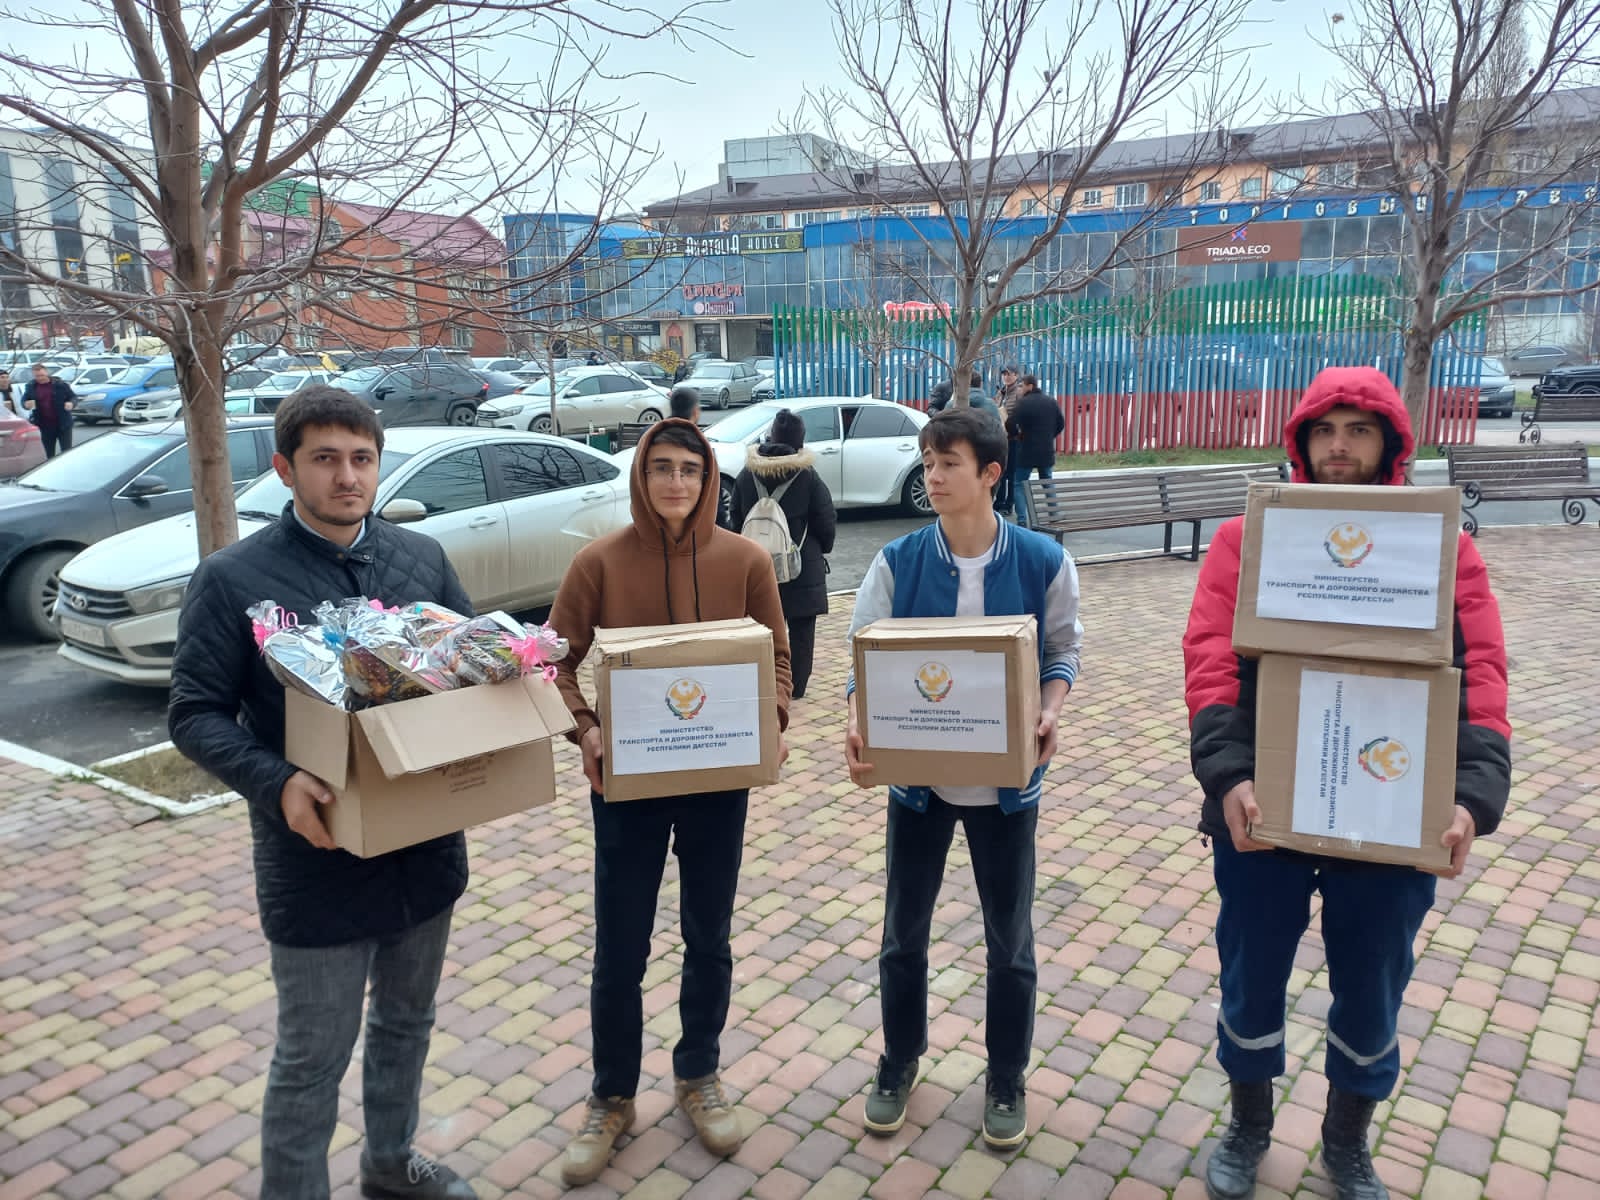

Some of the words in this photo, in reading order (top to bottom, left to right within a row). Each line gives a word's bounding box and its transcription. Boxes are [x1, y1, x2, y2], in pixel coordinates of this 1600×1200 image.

[748, 236, 780, 250] HOUSE
[1207, 246, 1246, 257] TRIADA
[1248, 244, 1271, 255] ECO
[1314, 574, 1379, 584] МИНИСТЕРСТВО
[1266, 581, 1317, 590] ТРАНСПОРТА
[1326, 584, 1378, 593] ДОРОЖНОГО
[1380, 586, 1430, 596] ХОЗЯЙСТВА
[1297, 592, 1350, 601] РЕСПУБЛИКИ
[1351, 593, 1394, 603] ДАГЕСТАН
[1335, 680, 1343, 729] ТРАНСПОРТА
[920, 716, 961, 724] ДОРОЖНОГО
[659, 725, 714, 734] МИНИСТЕРСТВО
[897, 724, 939, 732] РЕСПУБЛИКИ
[940, 725, 974, 733] ДАГЕСТАН
[1322, 709, 1330, 757] РЕСПУБЛИКИ
[619, 737, 664, 746] ТРАНСПОРТА
[671, 734, 714, 743] ДОРОЖНОГО
[646, 744, 691, 753] РЕСПУБЛИКИ
[692, 742, 727, 750] ДАГЕСТАН
[1330, 735, 1339, 784] ДОРОЖНОГО
[1341, 726, 1350, 786] МИНИСТЕРСТВО
[1319, 758, 1328, 798] ДАГЕСТАН
